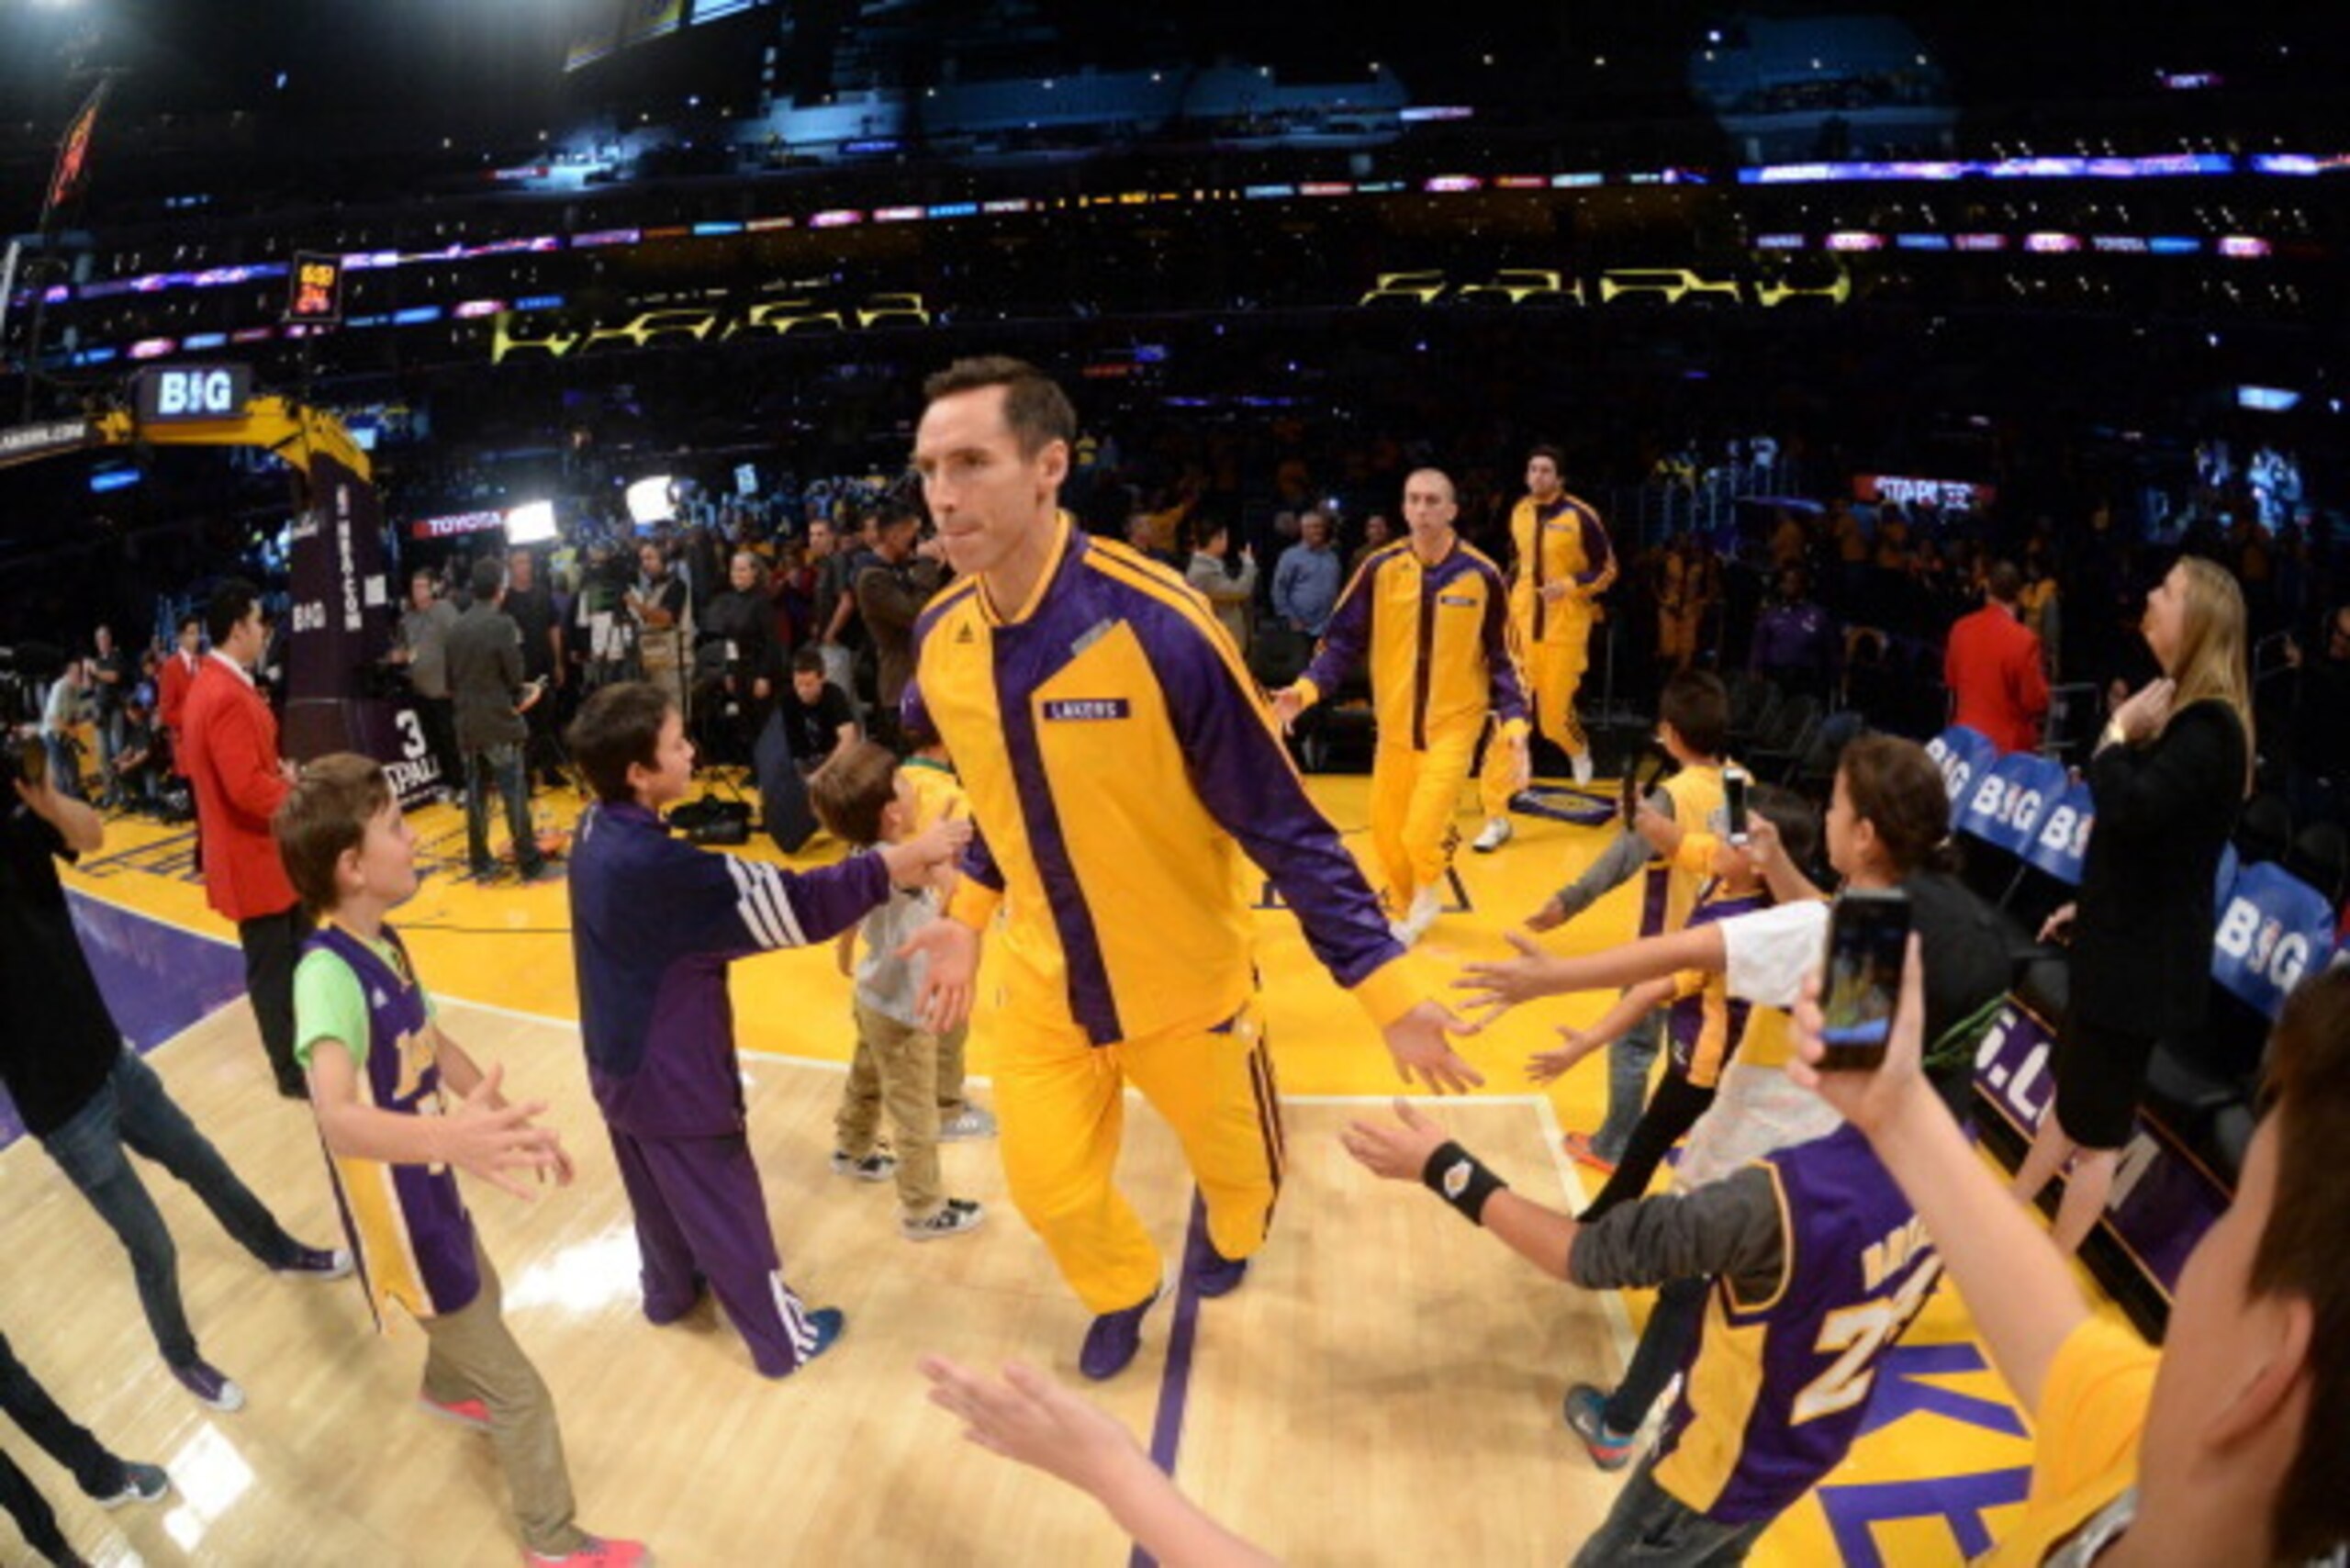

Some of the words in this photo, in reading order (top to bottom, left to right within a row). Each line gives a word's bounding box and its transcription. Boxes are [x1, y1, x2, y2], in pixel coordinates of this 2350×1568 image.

[158, 372, 231, 413] BIG
[428, 510, 501, 536] TOYOTA
[292, 601, 326, 633] BIG
[1051, 701, 1116, 718] LAKERS
[396, 709, 426, 759] 3
[1971, 774, 2042, 831] BIG
[2214, 895, 2309, 994] BIG
